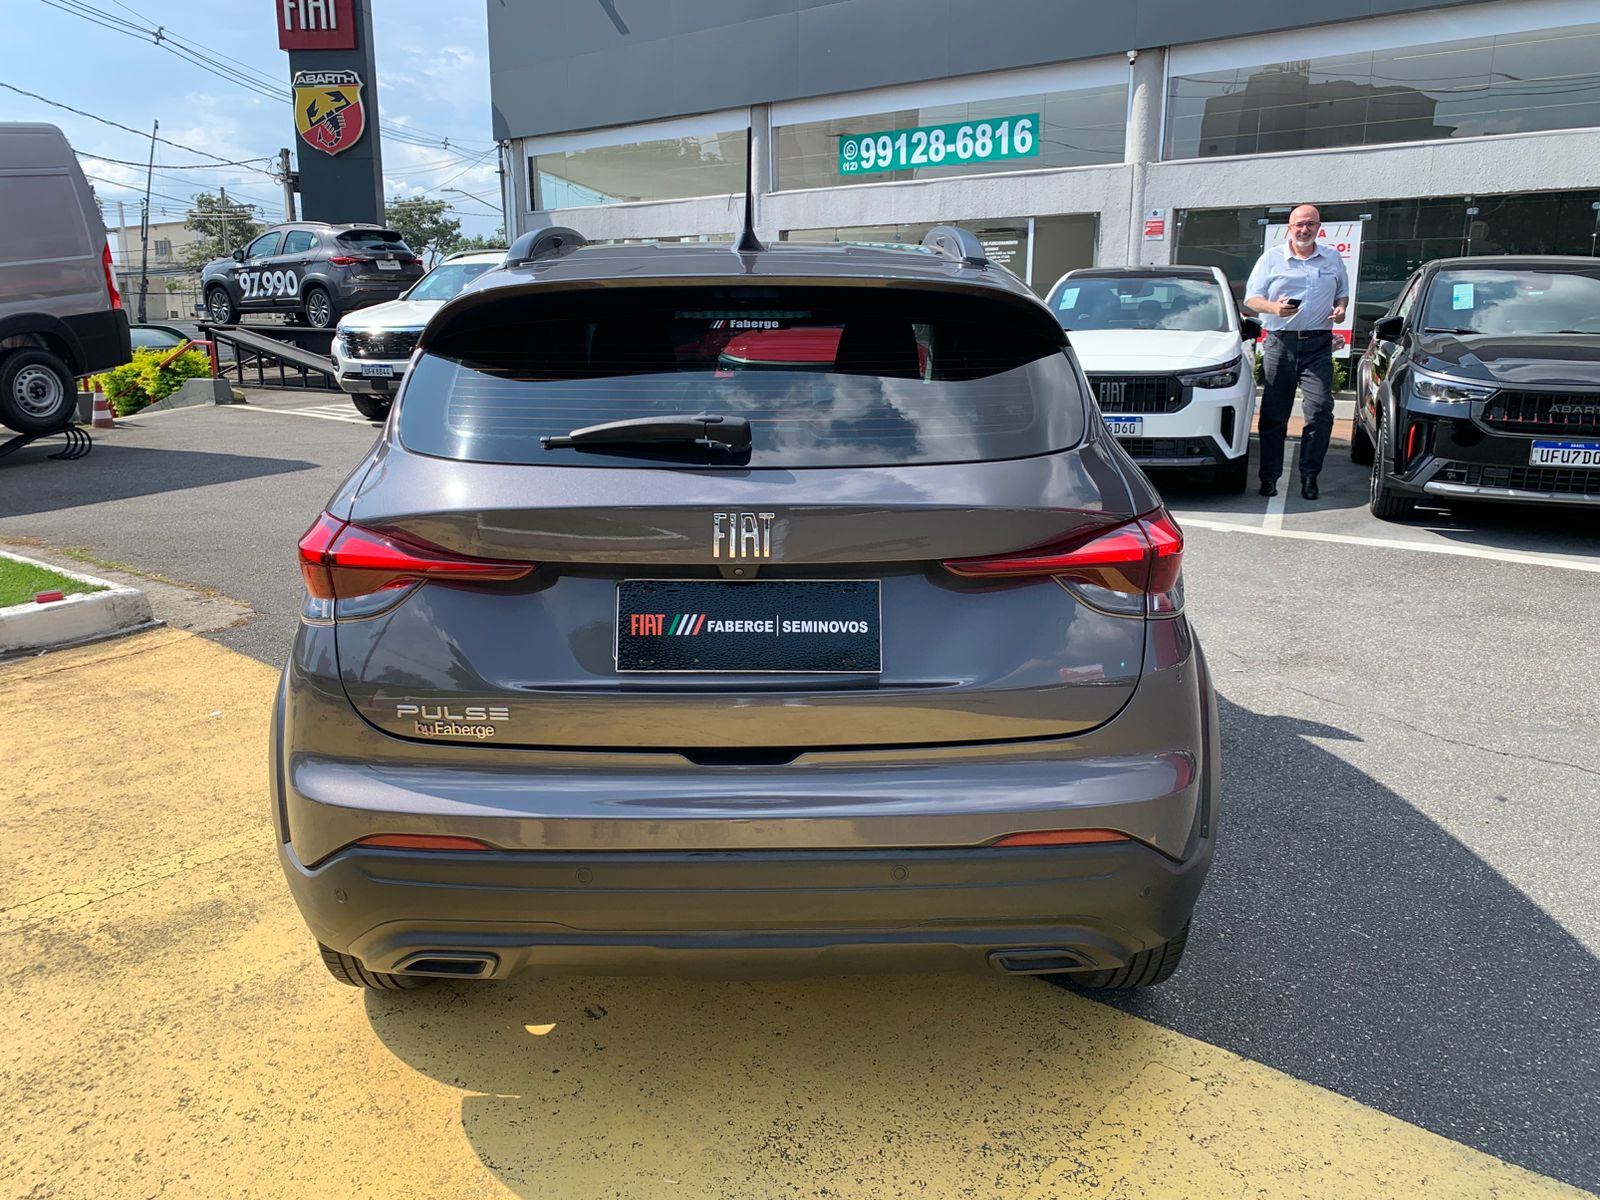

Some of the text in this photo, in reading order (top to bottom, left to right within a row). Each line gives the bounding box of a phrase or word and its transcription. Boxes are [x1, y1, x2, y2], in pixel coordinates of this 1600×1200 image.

[296, 73, 355, 84] ABARTH
[860, 118, 1033, 169] 99128-6816
[842, 162, 858, 171] (12)
[240, 270, 298, 297] 97.990
[730, 319, 779, 329] Faberge
[1100, 382, 1127, 402] FIAT
[713, 512, 775, 558] FIAT
[630, 614, 868, 636] FIAT FABERGE SEMINOVOS
[396, 704, 509, 721] PULSE
